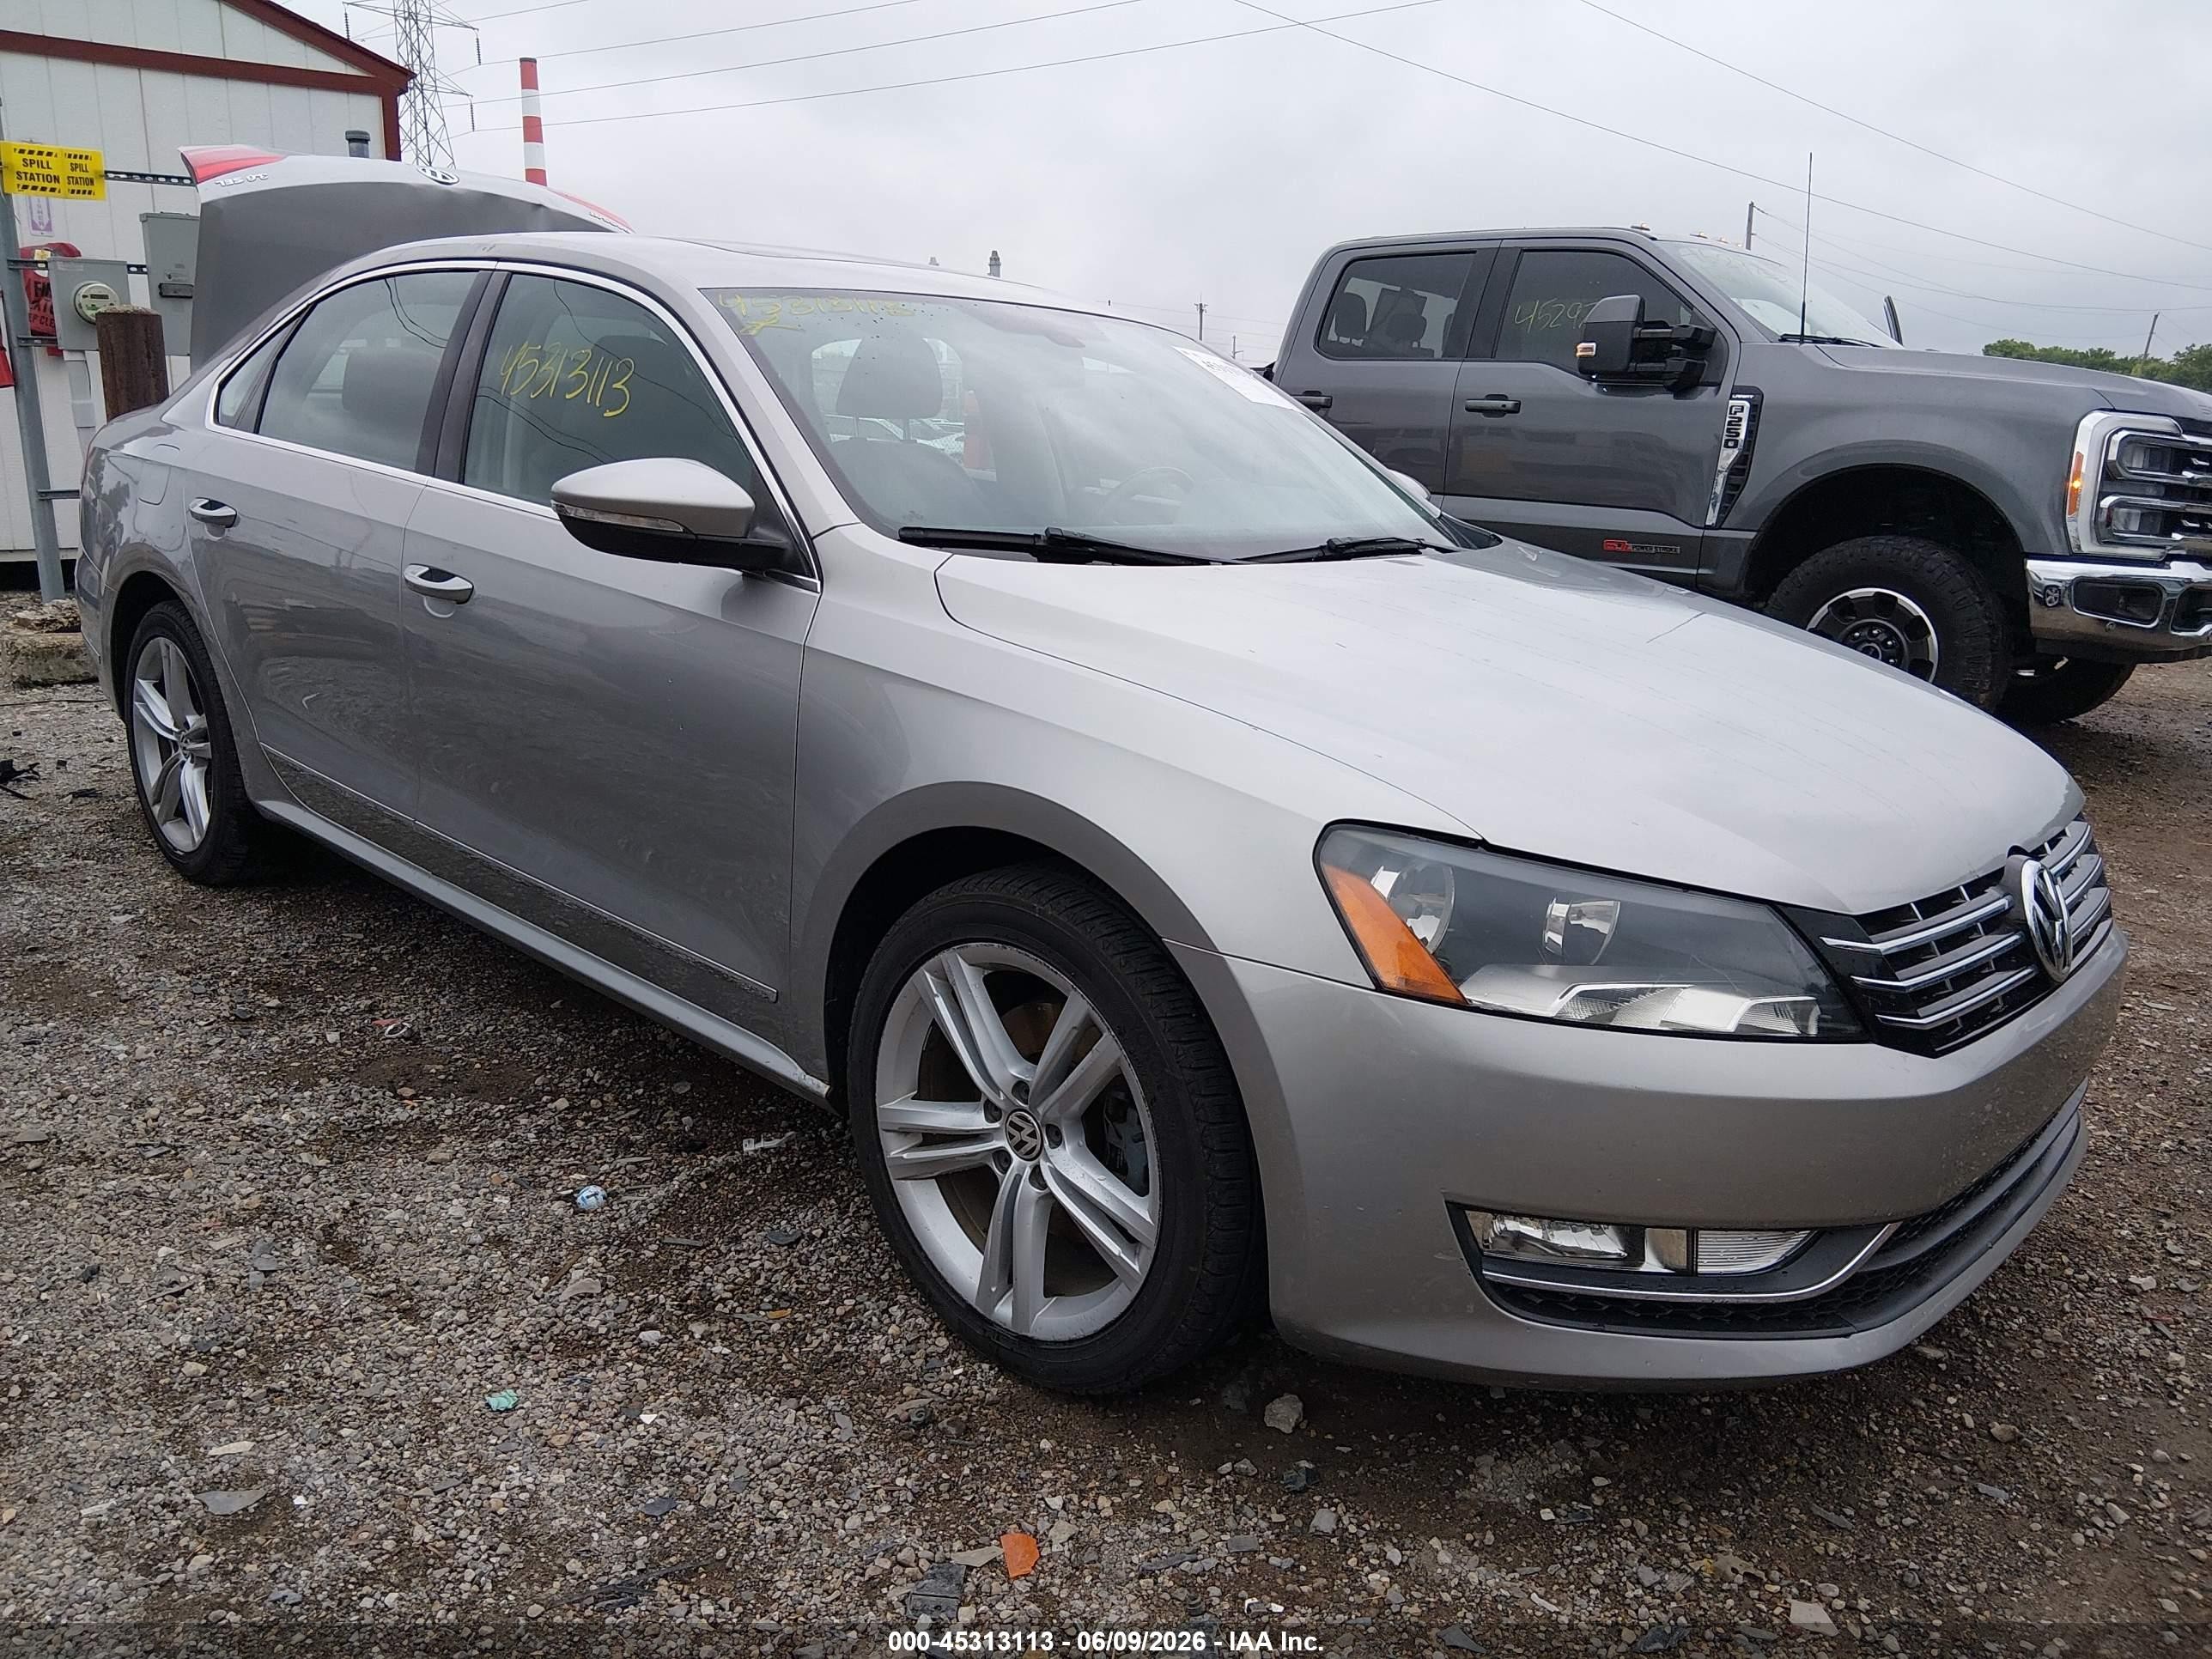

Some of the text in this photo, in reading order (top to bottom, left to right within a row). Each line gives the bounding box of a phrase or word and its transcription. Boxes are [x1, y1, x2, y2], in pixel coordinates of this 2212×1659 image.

[22, 158, 52, 170] SPILL
[70, 162, 89, 173] SPILL
[15, 171, 60, 184] STATION
[67, 175, 94, 186] STATION
[501, 341, 635, 417] 45313113
[1723, 404, 1745, 449] F250
